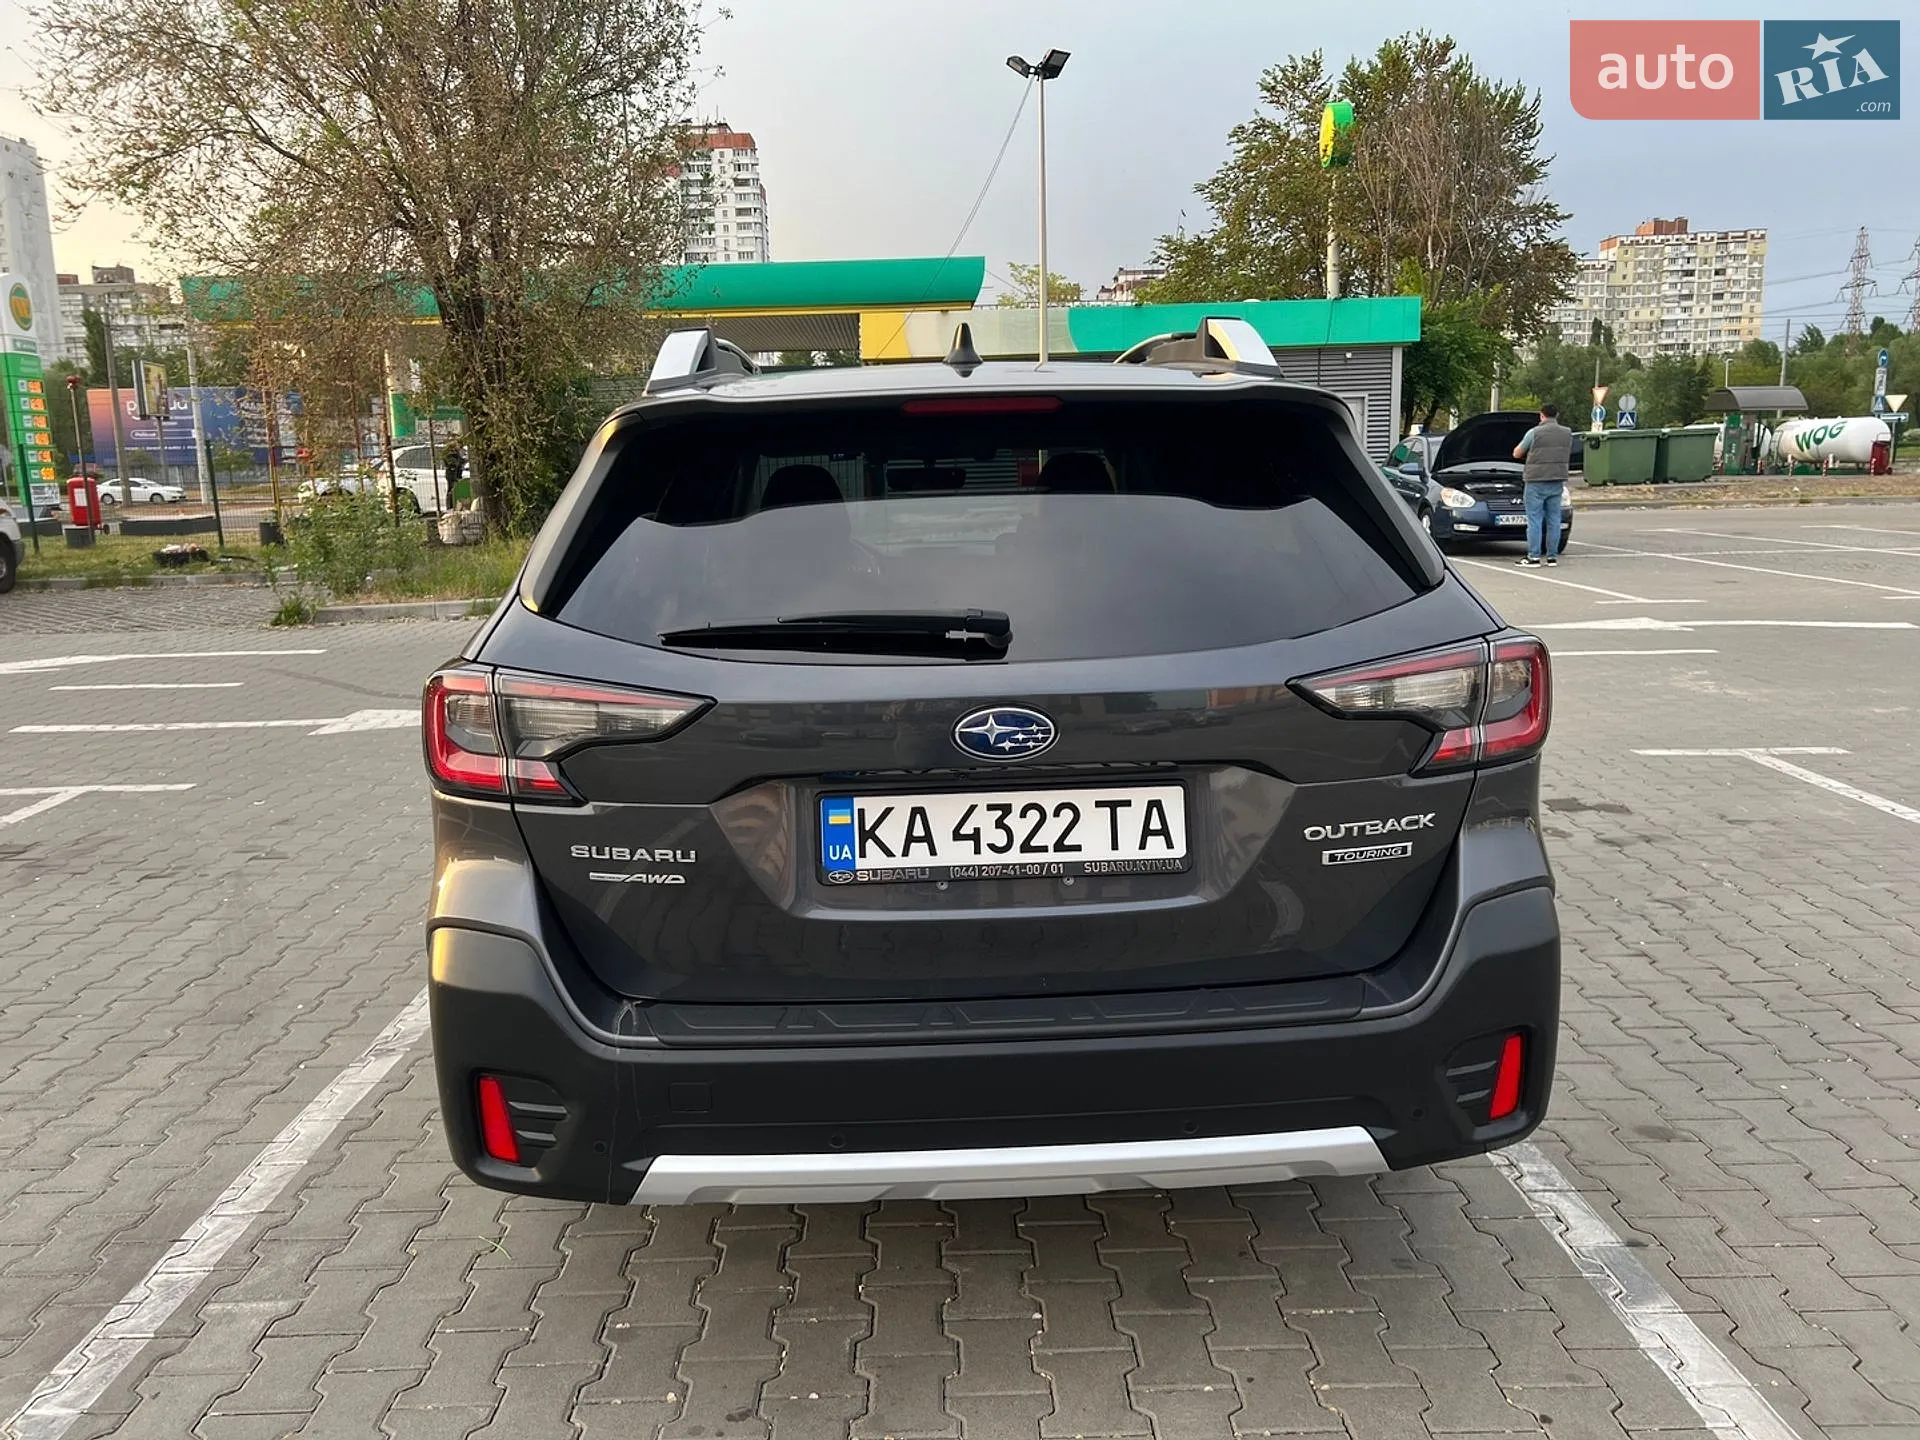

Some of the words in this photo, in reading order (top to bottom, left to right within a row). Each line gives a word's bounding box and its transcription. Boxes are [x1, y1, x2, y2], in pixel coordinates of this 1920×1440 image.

[1795, 421, 1848, 453] WOG
[857, 806, 938, 859] KA
[951, 801, 1082, 855] 4322
[1094, 799, 1175, 851] TA
[1303, 812, 1436, 841] OUTBACK
[570, 844, 697, 863] SUBARU
[829, 844, 852, 861] UA
[1334, 846, 1403, 862] TOURING
[624, 873, 686, 884] AWD
[856, 867, 930, 881] SUBARU
